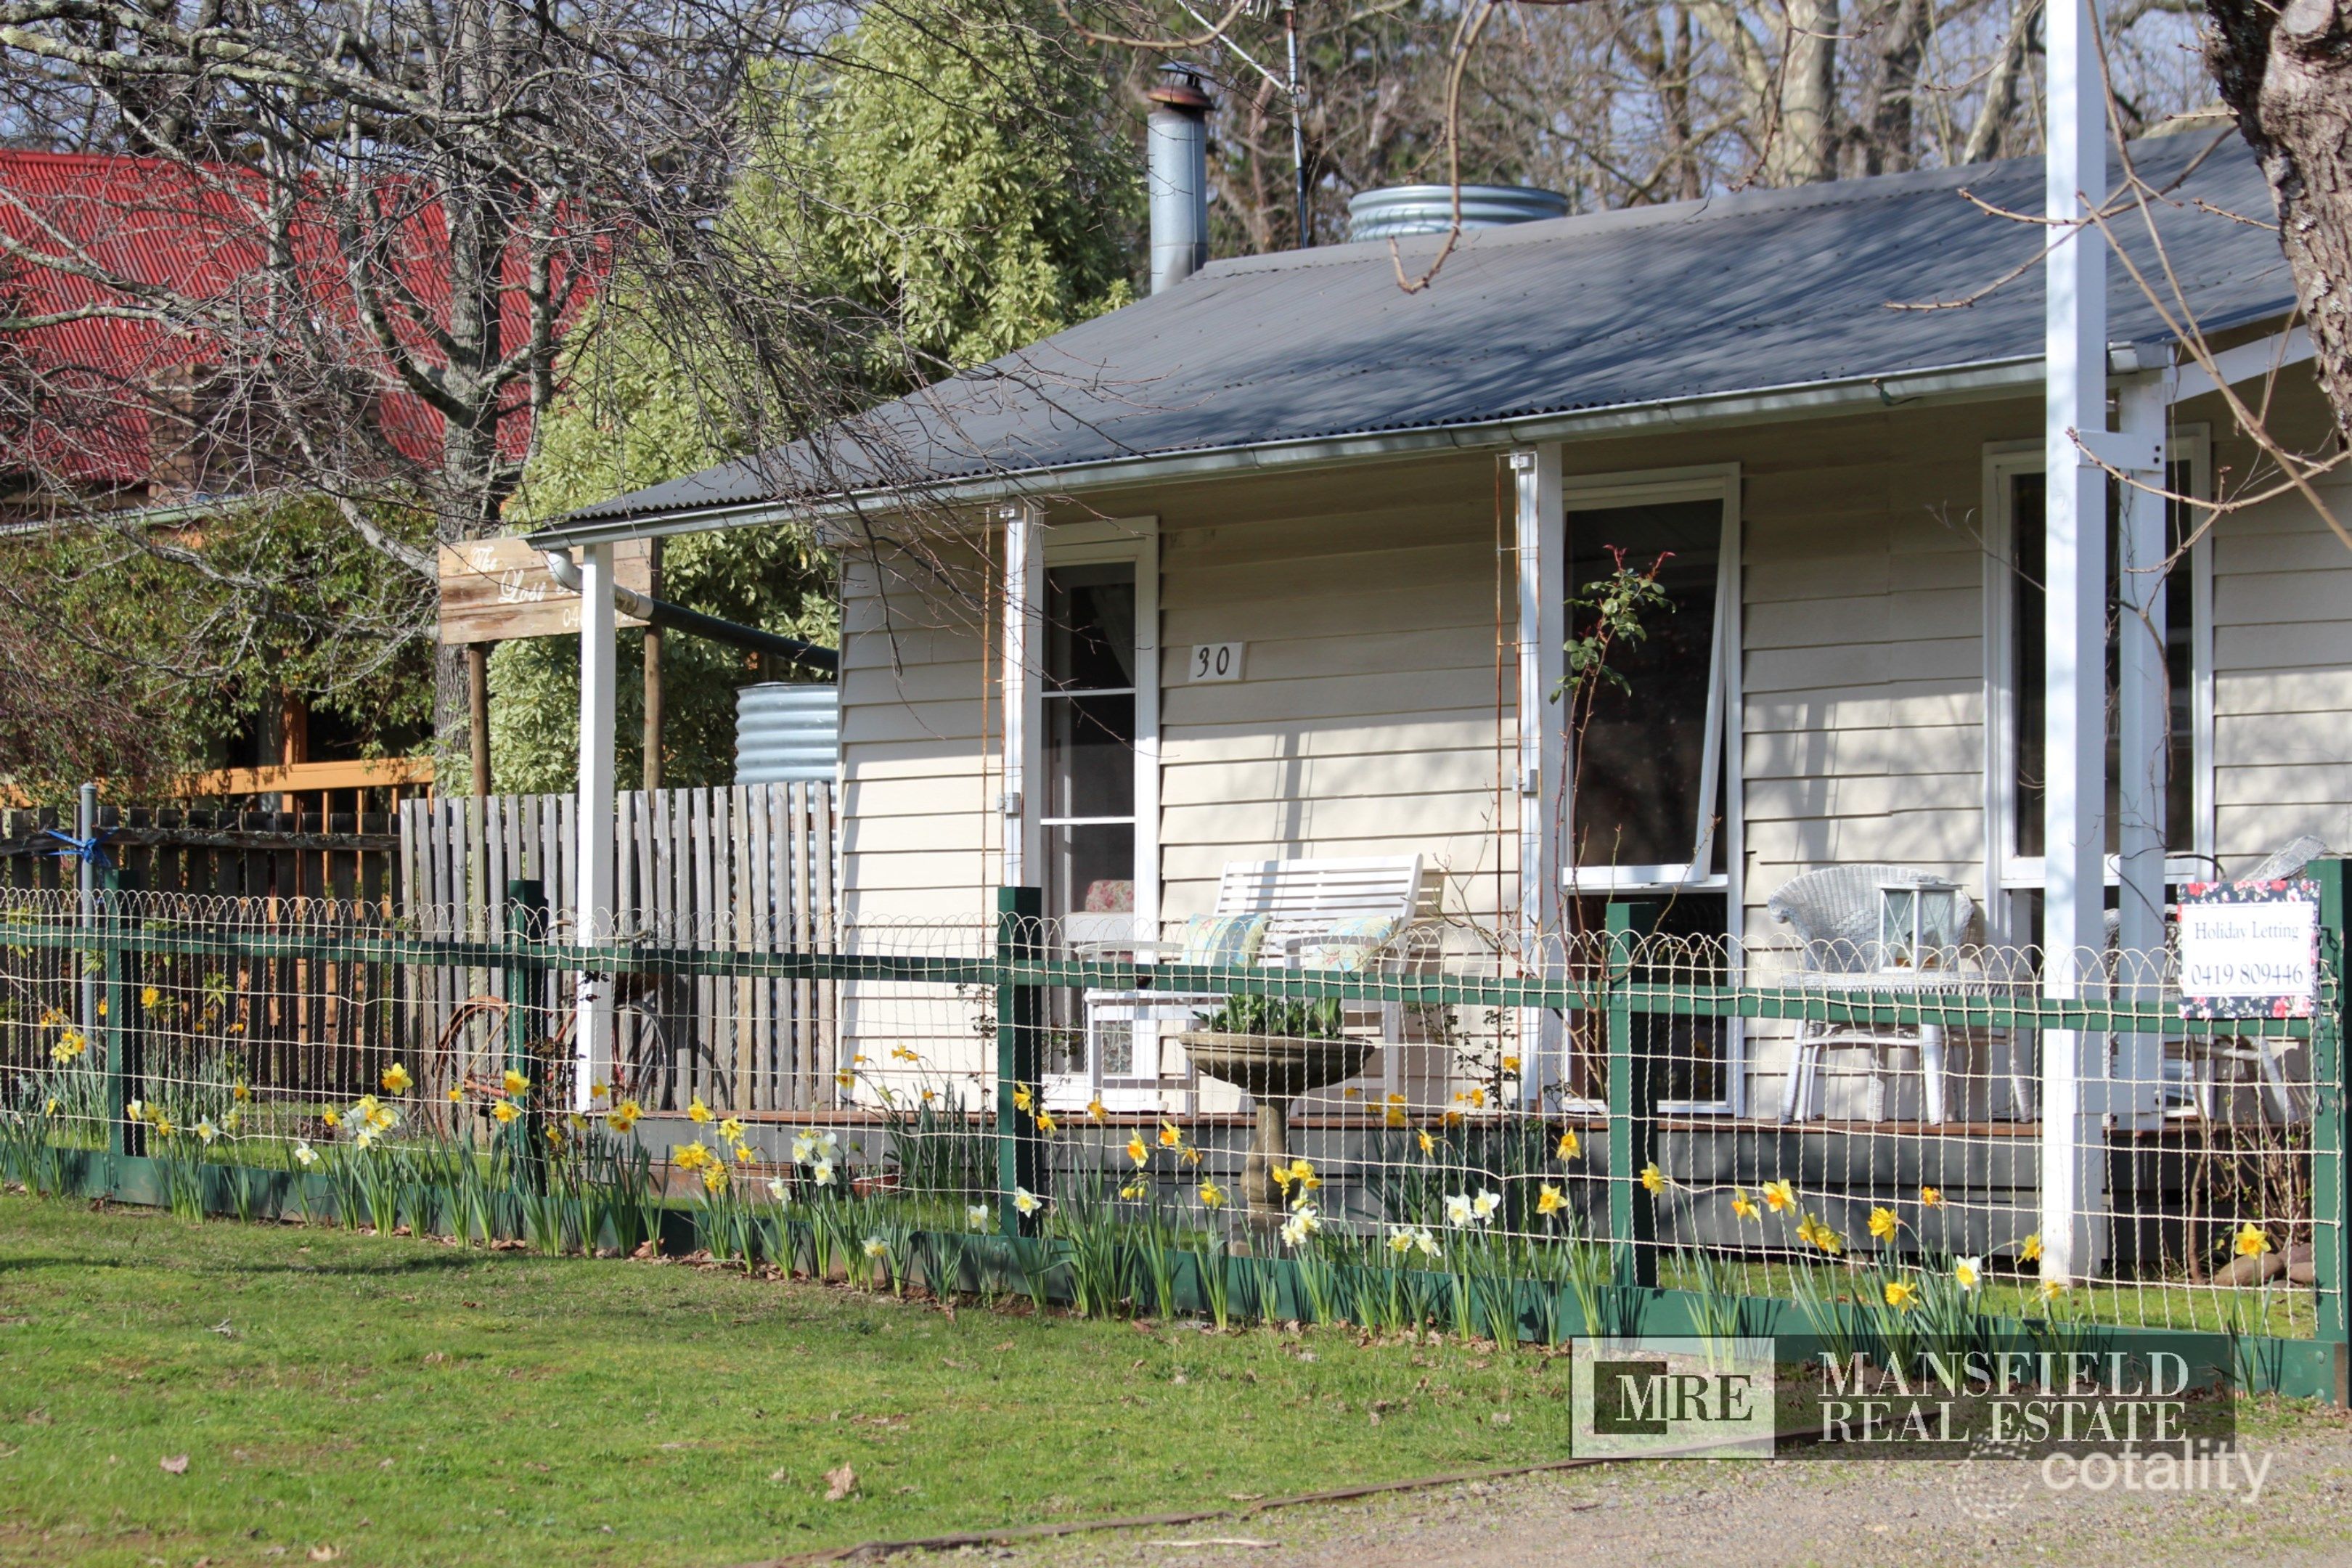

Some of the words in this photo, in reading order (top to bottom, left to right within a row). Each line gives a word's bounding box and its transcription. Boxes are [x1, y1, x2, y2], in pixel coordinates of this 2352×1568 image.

[467, 546, 498, 573] The
[1196, 646, 1230, 678] 30
[2194, 921, 2247, 942] Holiday
[2252, 920, 2299, 941] Letting
[2191, 963, 2234, 986] 0419
[2239, 962, 2303, 986] 809446
